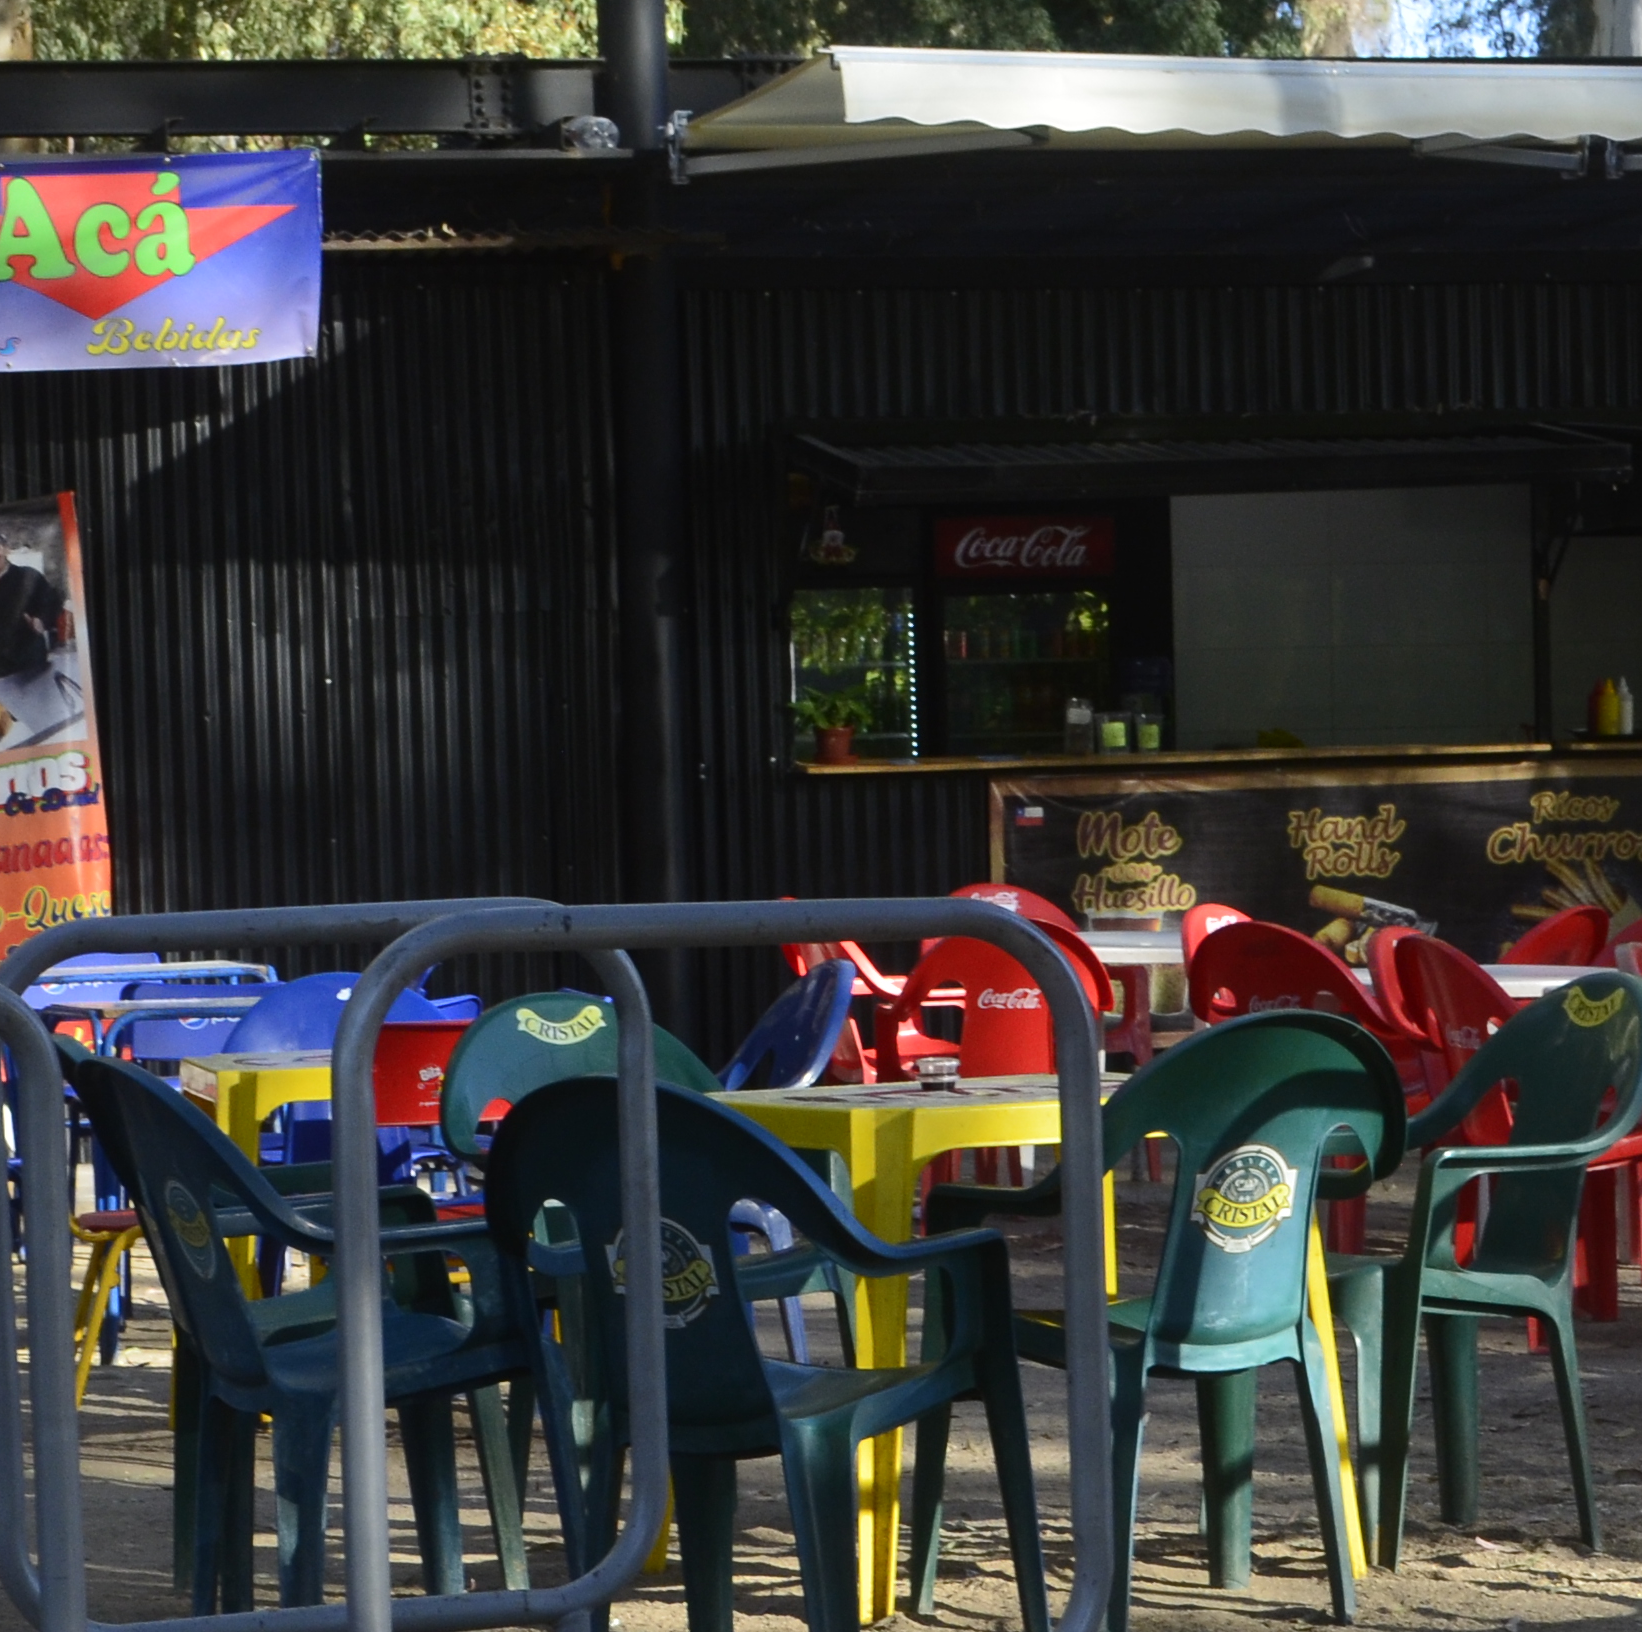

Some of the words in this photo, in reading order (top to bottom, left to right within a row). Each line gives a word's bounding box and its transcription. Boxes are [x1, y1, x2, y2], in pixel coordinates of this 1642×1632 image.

[87, 316, 262, 357] Bebidas
[955, 525, 1092, 568] Coca-Cola
[1288, 804, 1405, 848] Hand
[1530, 790, 1620, 824] Ricos
[1076, 811, 1182, 862] Mote
[1303, 842, 1400, 880] Rolls
[1072, 874, 1196, 915] Huesillo
[524, 1014, 596, 1042] CRISTAL
[1203, 1196, 1282, 1223] CRISTAL
